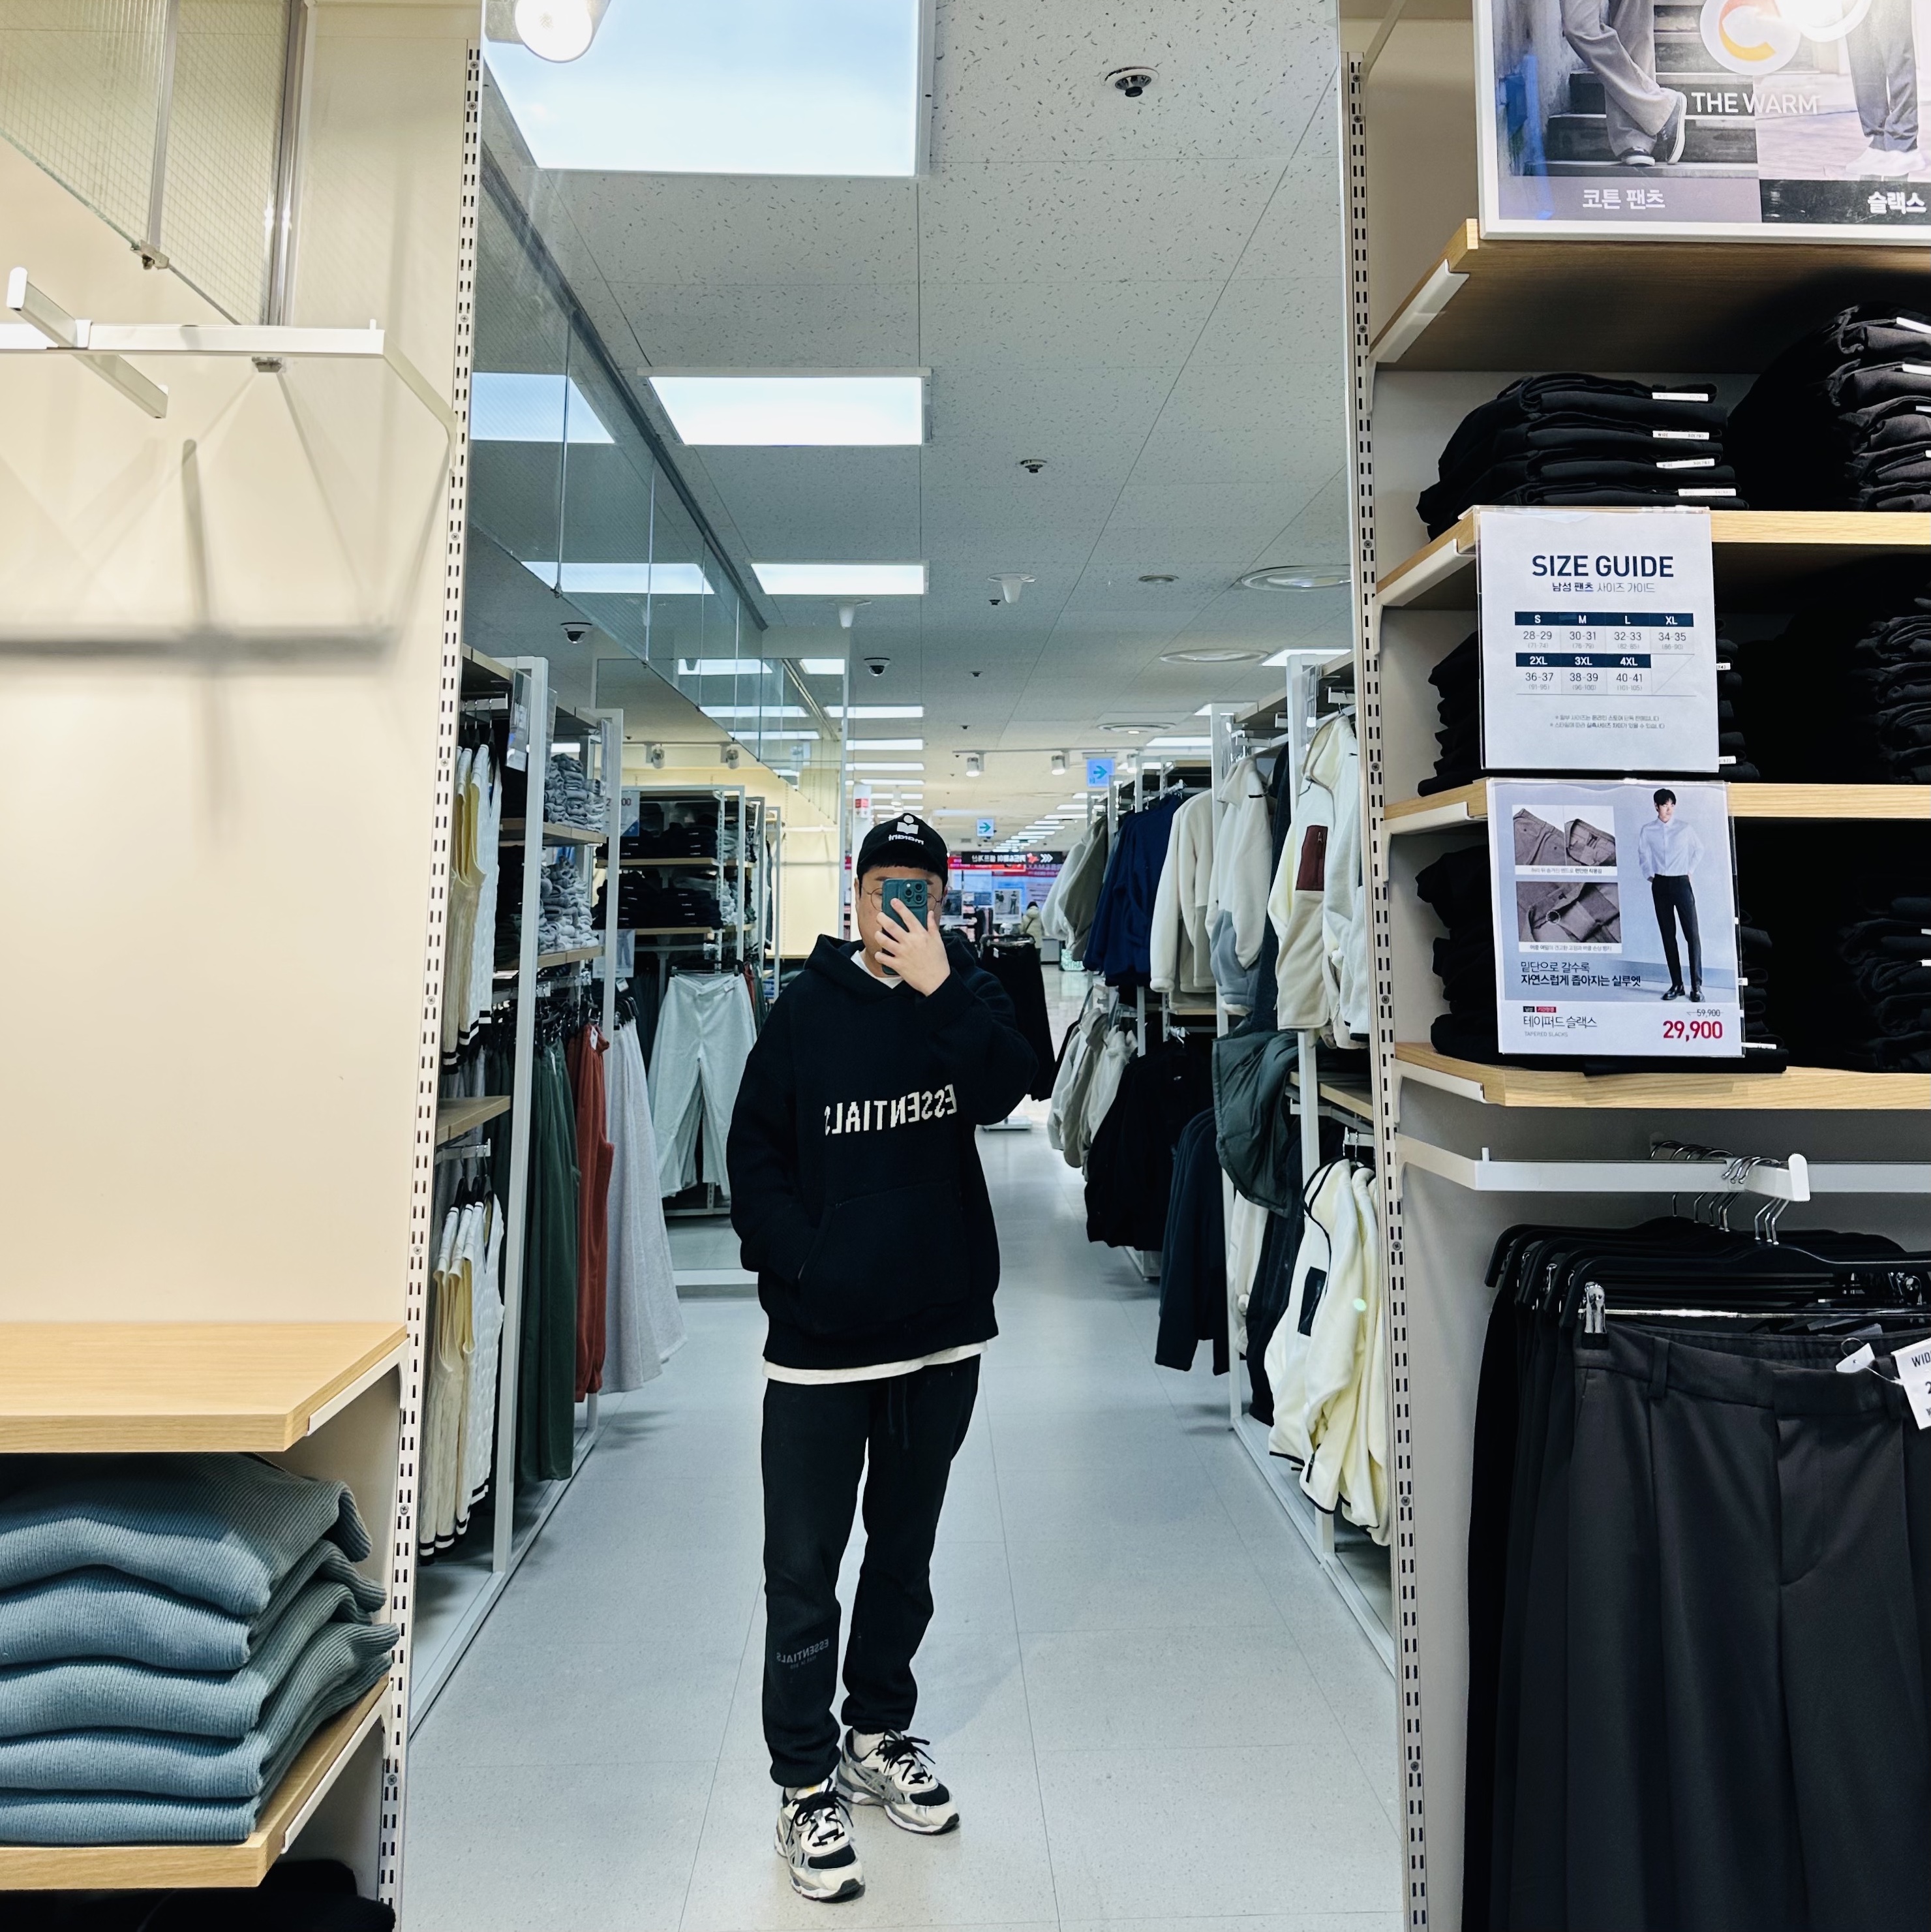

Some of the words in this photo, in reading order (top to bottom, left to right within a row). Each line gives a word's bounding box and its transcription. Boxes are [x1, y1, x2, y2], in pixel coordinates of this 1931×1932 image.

[1690, 92, 1738, 114] THE
[1742, 93, 1818, 115] WARM
[1582, 189, 1621, 210] 코튼
[1626, 189, 1666, 210] 팬츠
[1867, 192, 1927, 214] 슬랙스
[1532, 555, 1589, 577] SIZE
[1596, 555, 1674, 577] GUIDE
[1552, 583, 1571, 592] 남성
[1574, 582, 1594, 592] 팬츠
[1597, 583, 1625, 592] 사이즈
[1627, 583, 1655, 592] 가이드
[1534, 615, 1541, 624] S
[1578, 615, 1587, 624] M
[1624, 615, 1631, 624] L
[1665, 616, 1678, 625] XL
[1523, 631, 1552, 640] 28-29
[1570, 631, 1596, 640] 30-31
[1614, 632, 1641, 641] 32-33
[1658, 632, 1686, 641] 34-35
[1529, 656, 1547, 666] 2XL
[1574, 656, 1592, 666] 3XL
[1620, 657, 1638, 666] 4XL
[1525, 672, 1554, 682] 36-37
[1570, 673, 1598, 682] 38-39
[1616, 673, 1643, 682] 40-41
[1521, 961, 1559, 972] 밑단으로
[1561, 962, 1590, 973] 갈수록
[1521, 974, 1569, 986] 자연스럽게
[1571, 975, 1610, 987] 좁아지는
[1696, 1009, 1720, 1018] 59,900
[1523, 1015, 1565, 1028] 테이퍼드
[1566, 1015, 1598, 1028] 슬랙스
[1663, 1020, 1723, 1042] 29,900
[1911, 1349, 1931, 1368] WID
